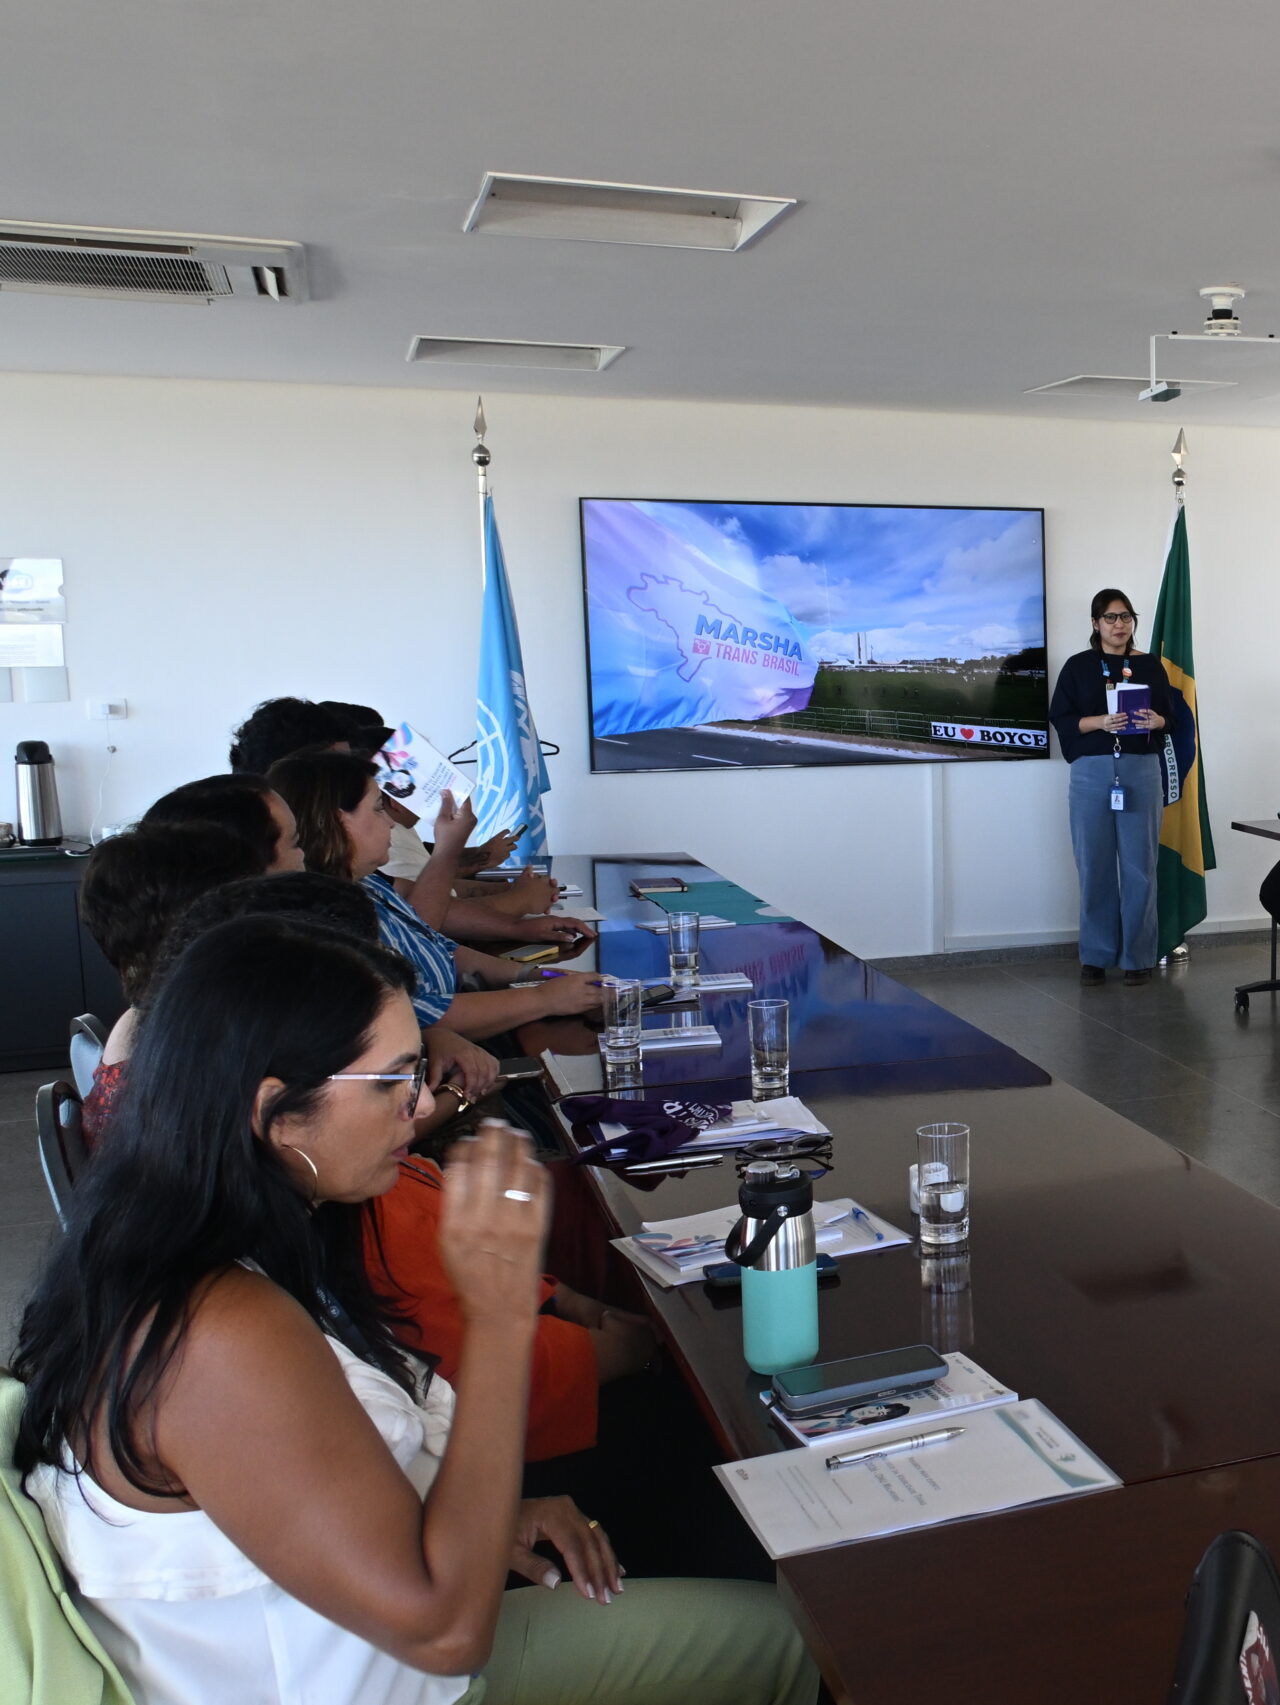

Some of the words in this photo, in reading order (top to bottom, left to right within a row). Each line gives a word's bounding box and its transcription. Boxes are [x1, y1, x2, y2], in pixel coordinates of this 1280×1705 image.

[695, 614, 803, 661] MARSHA
[715, 642, 759, 665] TRANS
[762, 653, 800, 676] BRASIL
[932, 725, 956, 737] EU
[979, 729, 1047, 747] BOYCE
